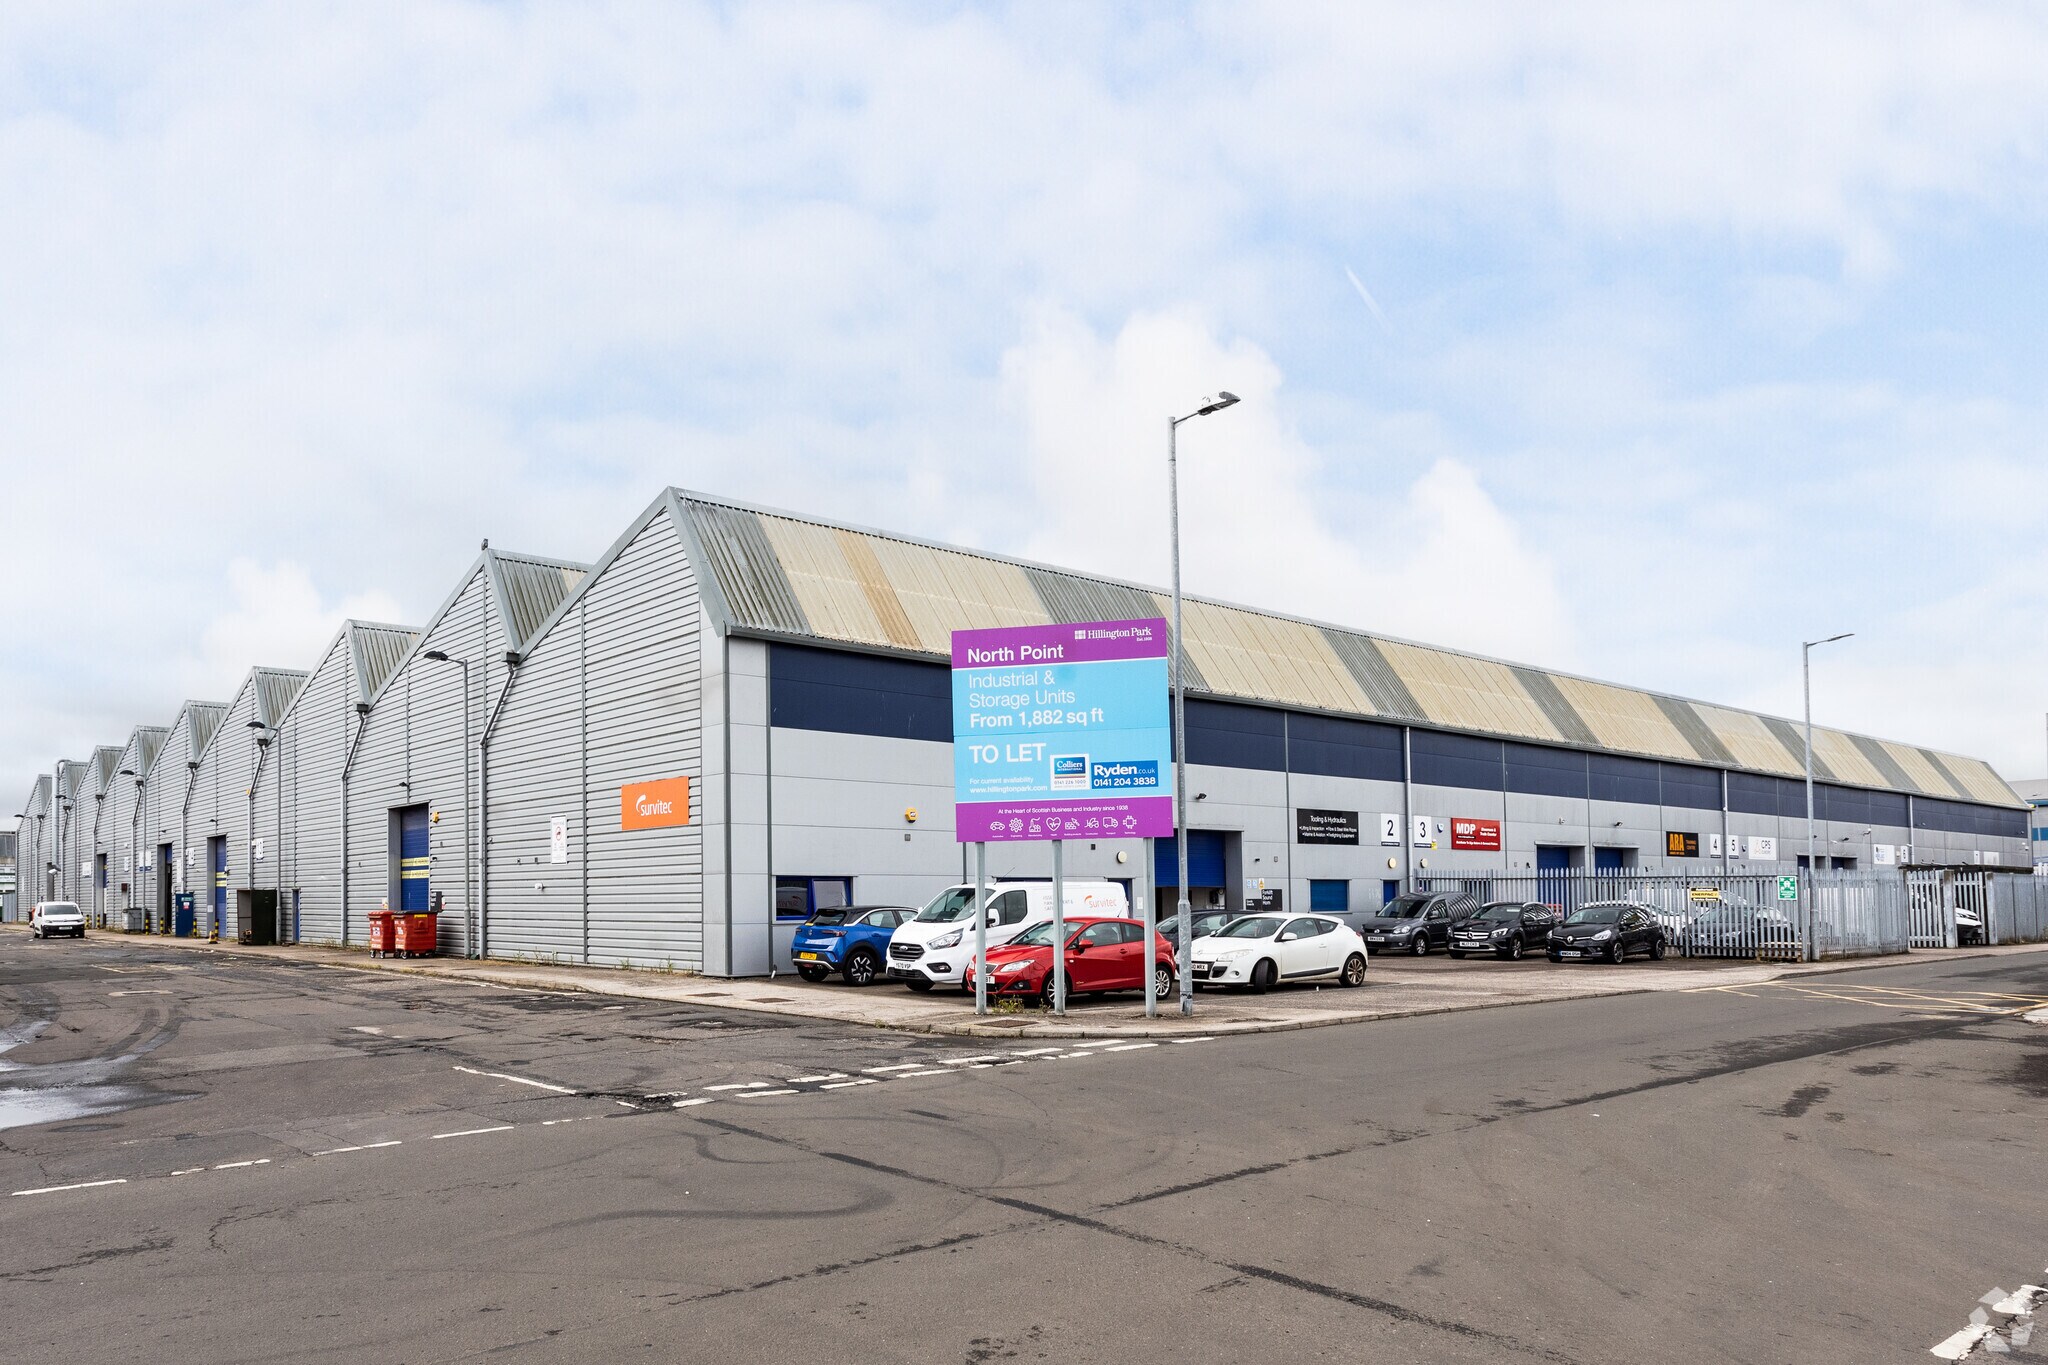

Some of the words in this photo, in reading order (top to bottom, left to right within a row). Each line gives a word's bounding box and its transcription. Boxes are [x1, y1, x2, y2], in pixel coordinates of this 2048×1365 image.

[1088, 628, 1130, 641] Hillington
[1131, 627, 1152, 637] Park
[968, 646, 1014, 664] North
[1021, 644, 1064, 660] Point
[969, 671, 1038, 689] Industrial
[1044, 669, 1056, 685] &
[969, 692, 1030, 710] Storage
[1035, 689, 1076, 705] Units
[970, 713, 1013, 728] From
[1019, 710, 1063, 728] 1,882
[1067, 711, 1087, 726] sq
[1091, 708, 1104, 723] ft
[968, 744, 999, 764] TO
[1006, 743, 1046, 763] LET
[1056, 760, 1083, 769] Colliers
[1002, 776, 1034, 785] availability
[1094, 778, 1111, 787] 0141
[1114, 777, 1131, 786] 204
[1133, 776, 1156, 785] 3838
[970, 784, 1047, 794] www.hillingtonpark.com
[640, 799, 673, 816] survitec
[1310, 816, 1324, 824] Tooling
[1387, 820, 1394, 836] 2
[1420, 822, 1426, 838] 3
[1456, 823, 1476, 835] MDP
[1669, 833, 1685, 851] ARA
[1713, 838, 1718, 850] 4
[1732, 839, 1736, 852] 5
[1761, 839, 1771, 850] CPS
[1088, 899, 1117, 908] survitec
